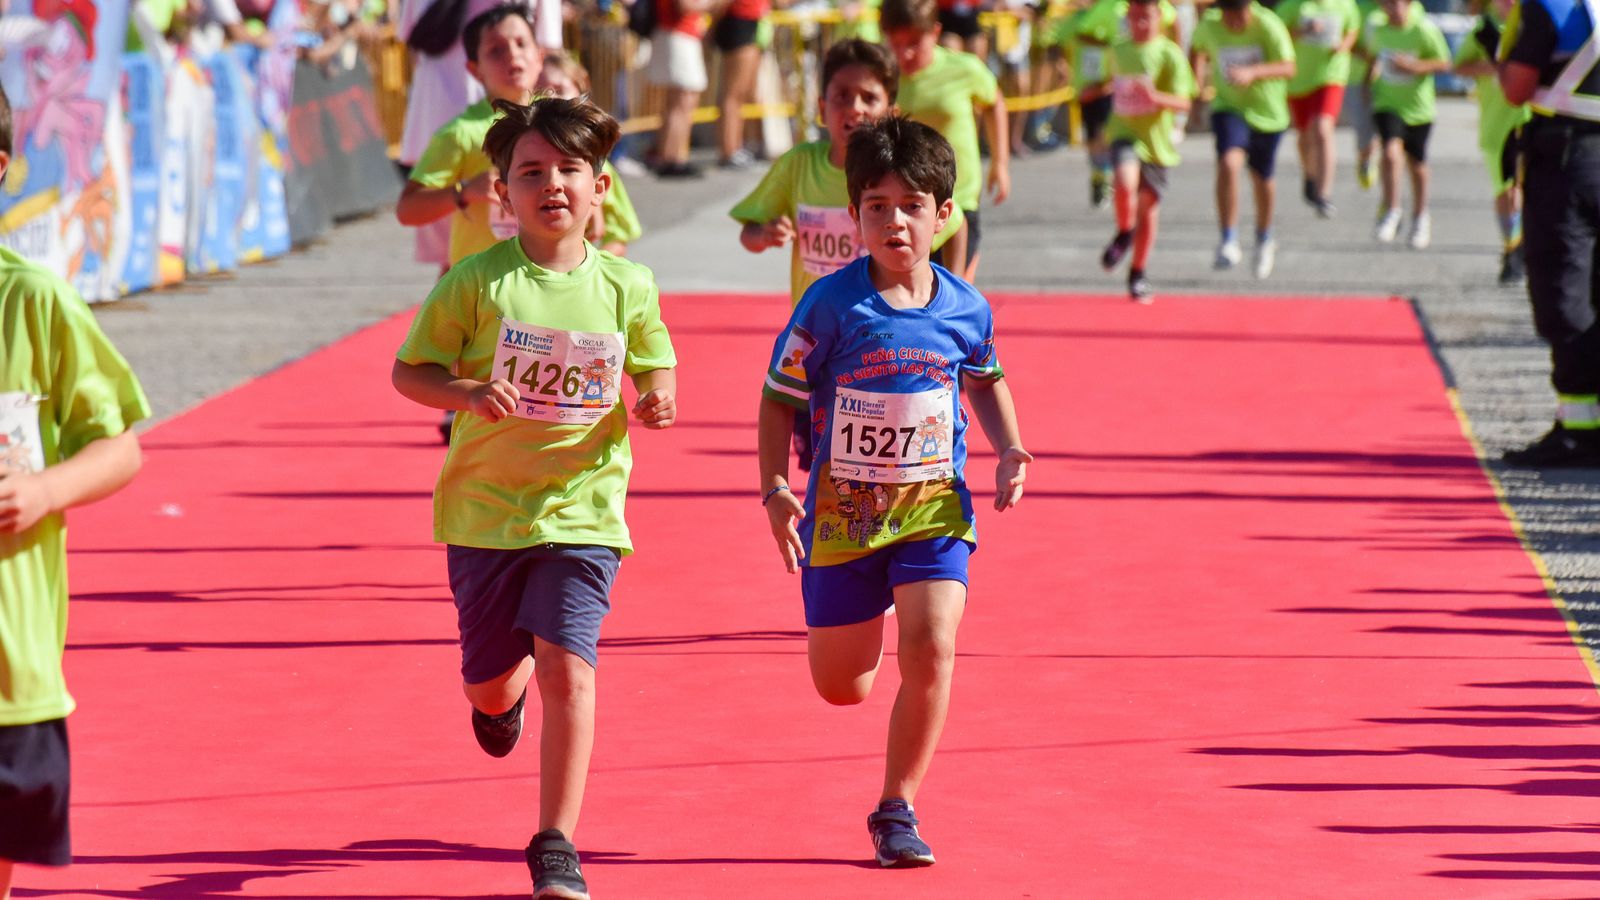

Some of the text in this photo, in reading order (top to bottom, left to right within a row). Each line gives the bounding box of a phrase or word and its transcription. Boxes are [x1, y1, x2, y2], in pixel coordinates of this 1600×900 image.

[802, 231, 852, 258] 1406
[504, 328, 554, 347] XXI Carrera
[528, 341, 553, 351] Popular
[578, 338, 605, 347] OSCAR
[862, 347, 896, 365] PEÑA
[503, 356, 582, 398] 1426
[853, 362, 899, 381] SIENTO
[900, 362, 925, 375] LAS
[840, 397, 885, 412] XXI Carrera
[862, 408, 886, 416] Popular
[841, 422, 917, 458] 1527
